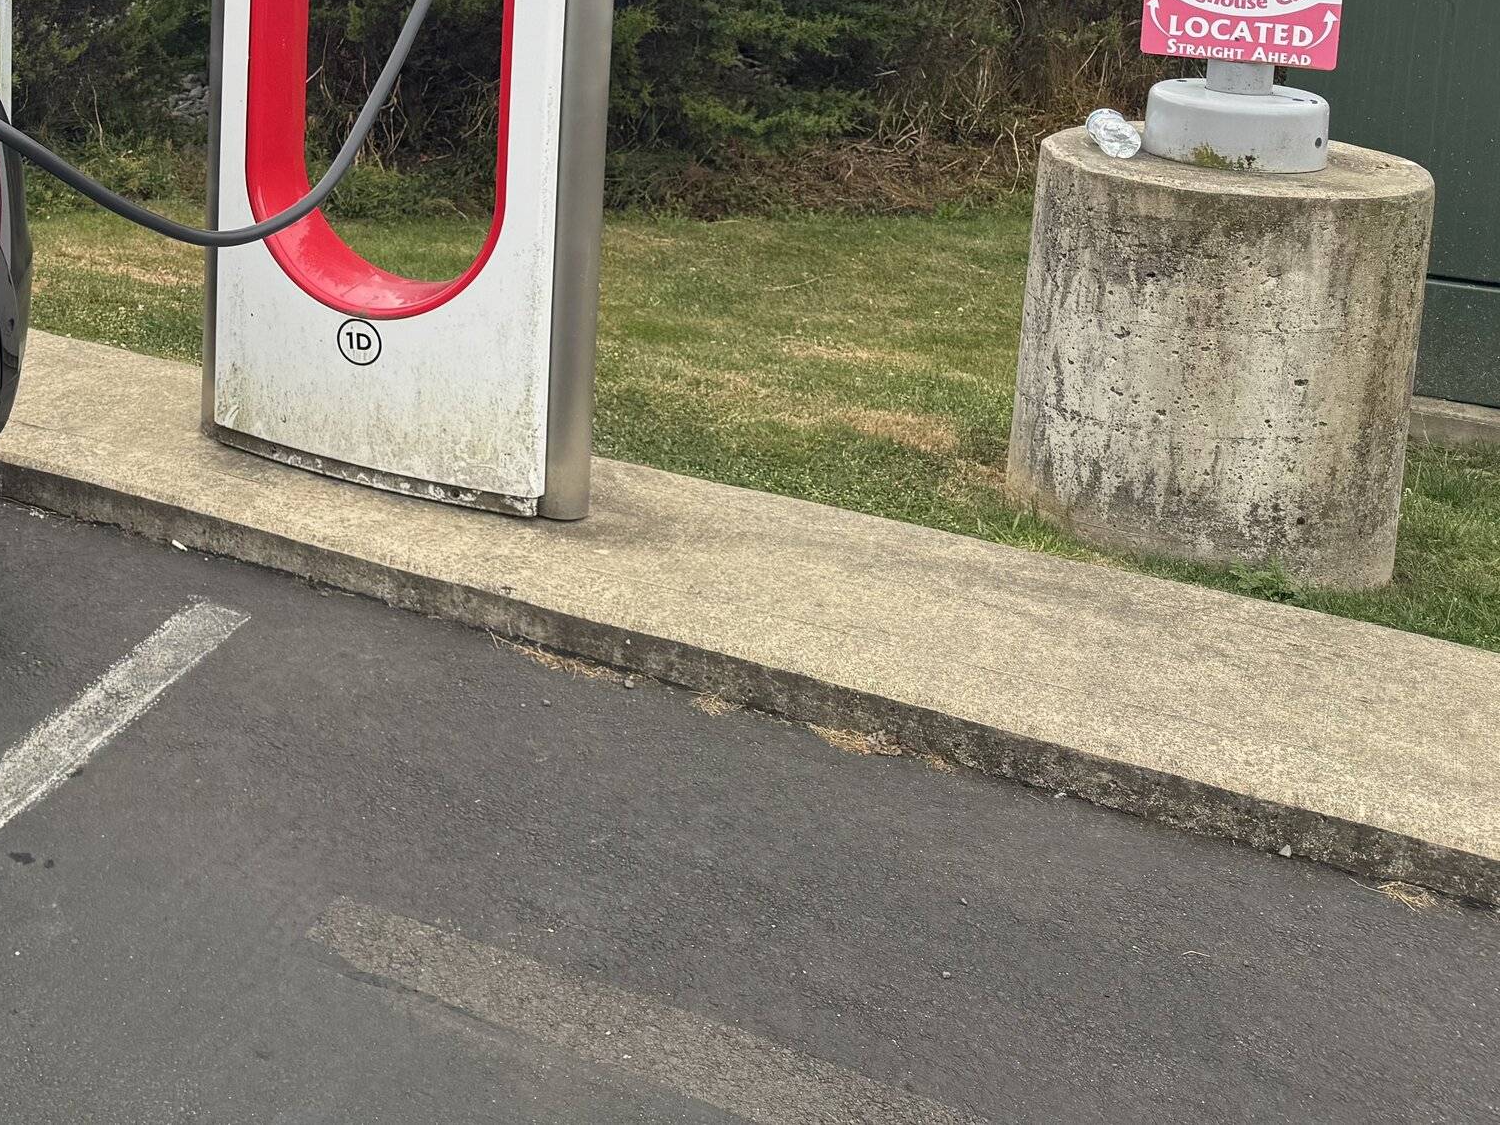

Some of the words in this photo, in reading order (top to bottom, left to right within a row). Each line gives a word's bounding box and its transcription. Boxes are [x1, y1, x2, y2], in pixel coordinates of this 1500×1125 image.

[1168, 14, 1315, 48] LOCATED
[1166, 38, 1245, 61] STRAIGHT
[1251, 46, 1312, 67] AHEAD
[345, 331, 372, 351] 1D
